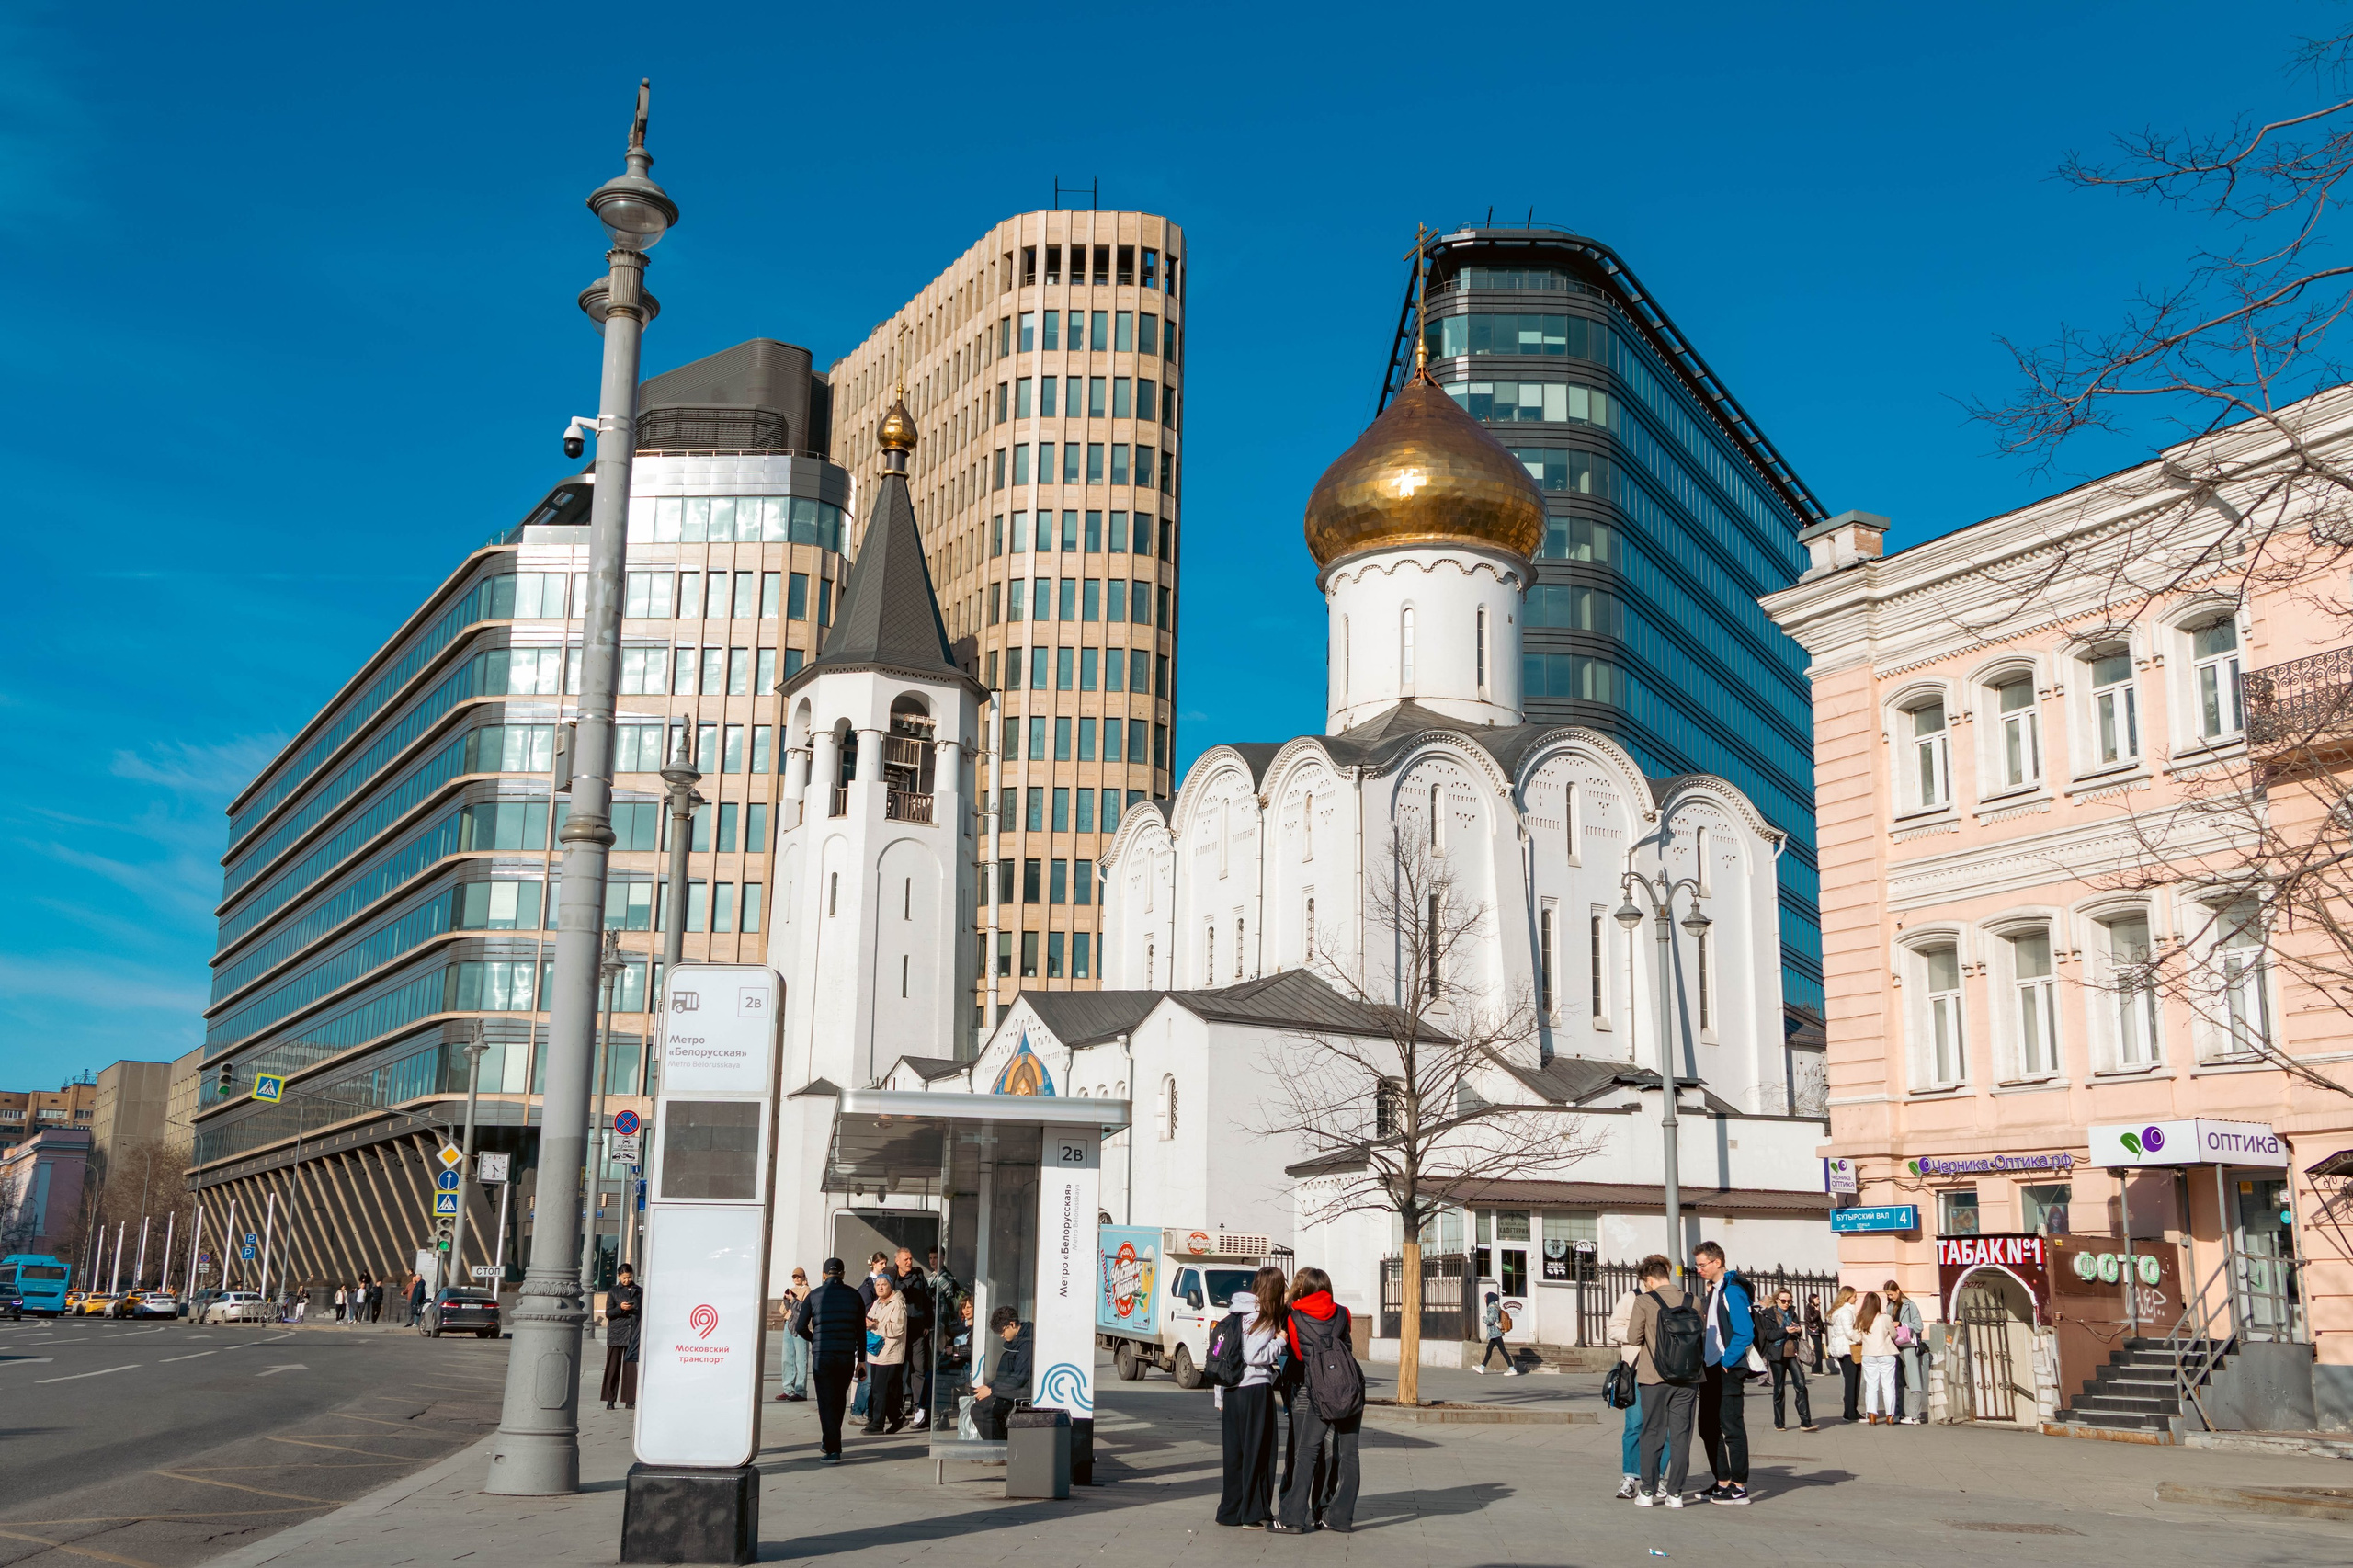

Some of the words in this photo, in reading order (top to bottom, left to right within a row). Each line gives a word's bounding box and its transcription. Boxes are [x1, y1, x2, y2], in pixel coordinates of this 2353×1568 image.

[669, 1035, 705, 1045] Метро
[668, 1047, 747, 1059] «Белорусская»
[692, 1061, 741, 1069] Belorusskaya
[2207, 1131, 2279, 1154] оптика
[1931, 1152, 2072, 1175] Черника-Оптика.рф
[1061, 1183, 1073, 1260] «Белорусская»
[1836, 1211, 1875, 1221] БУТЫРСКИЙ
[1876, 1211, 1890, 1220] ВАЛ
[1899, 1210, 1907, 1224] 4
[1936, 1238, 2006, 1265] ТАБАК
[476, 1267, 501, 1276] СТОП
[2073, 1251, 2161, 1285] ФОТО
[1059, 1262, 1069, 1298] Метро
[675, 1345, 730, 1353] Московский
